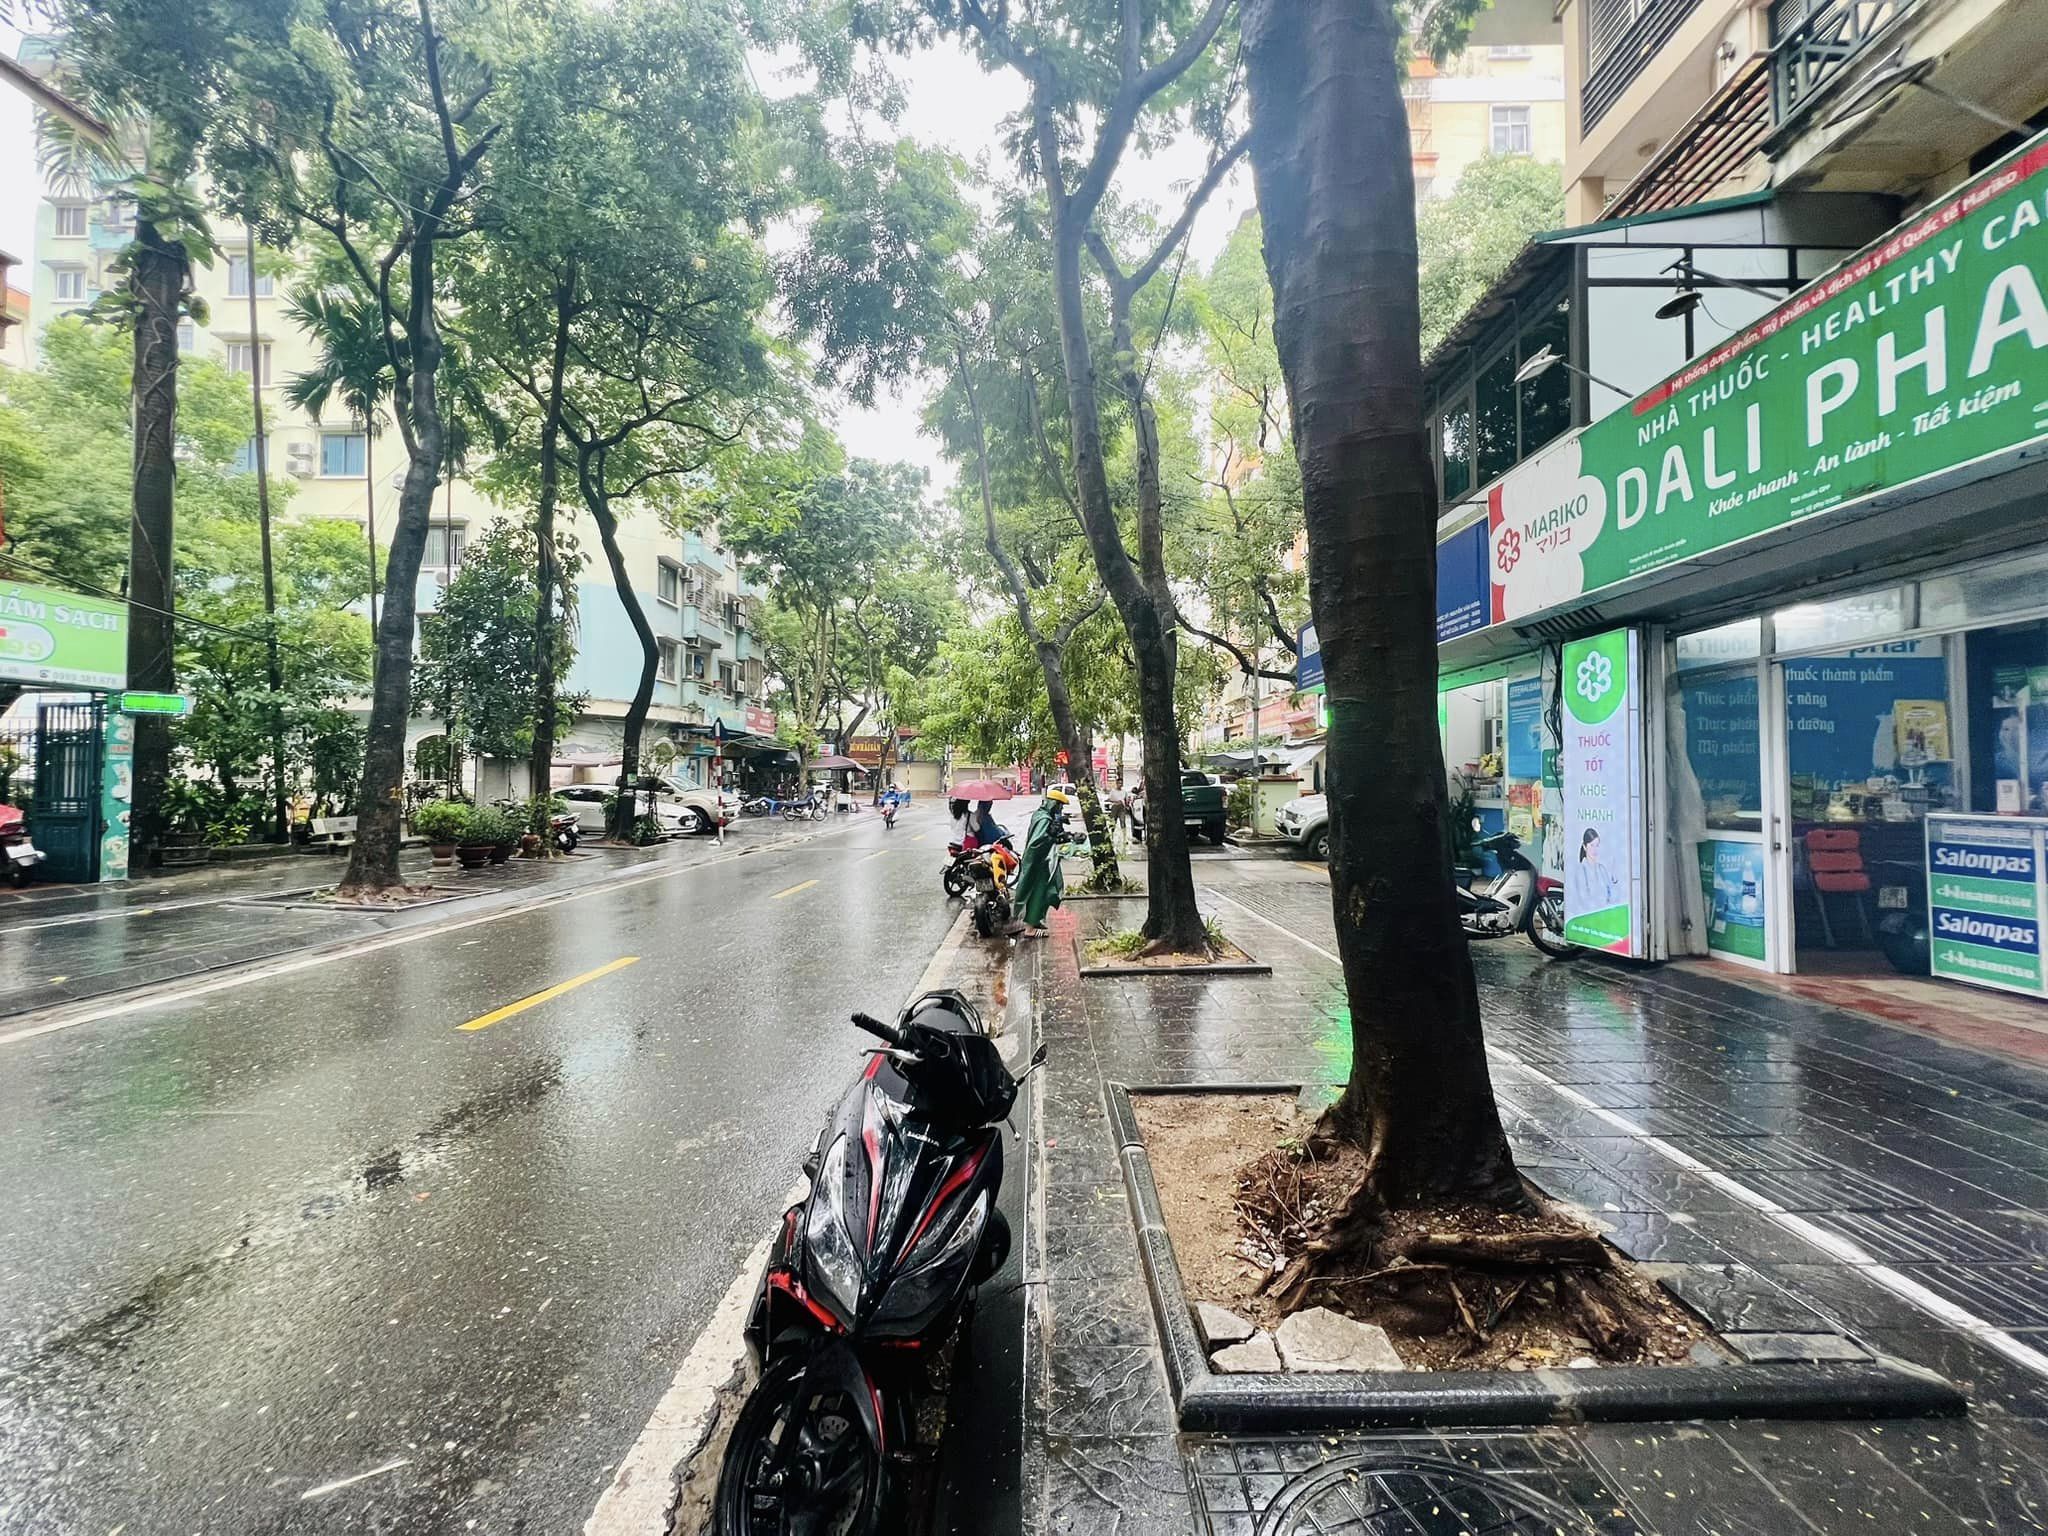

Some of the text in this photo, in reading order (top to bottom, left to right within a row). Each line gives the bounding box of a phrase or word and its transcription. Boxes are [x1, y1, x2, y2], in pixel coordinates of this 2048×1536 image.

[1811, 288, 1826, 304] và
[1827, 273, 1853, 294] dịch
[1872, 254, 1883, 270] y
[1962, 170, 2018, 211] Mariko
[1638, 403, 1680, 447] NHÀ
[1688, 353, 1769, 417] THUỐC
[1802, 239, 1964, 355] HEALTHY
[1983, 188, 2048, 251] CA
[1747, 469, 1799, 502] nhanh
[1813, 453, 1840, 477] An
[1844, 431, 1892, 463] lành
[1912, 401, 1952, 436] Tiết
[1956, 380, 2022, 419] kiệm
[1616, 402, 1761, 531] DALI
[1524, 494, 1588, 543] MARIKO
[1536, 527, 1571, 554] マリコ
[54, 604, 119, 632] SẠCH
[1577, 729, 1612, 748] THUỐC
[1584, 754, 1605, 772] TỐT
[1576, 807, 1614, 822] NHANH
[1935, 847, 2032, 874] Salonpas
[1936, 912, 2036, 945] Salonpas
